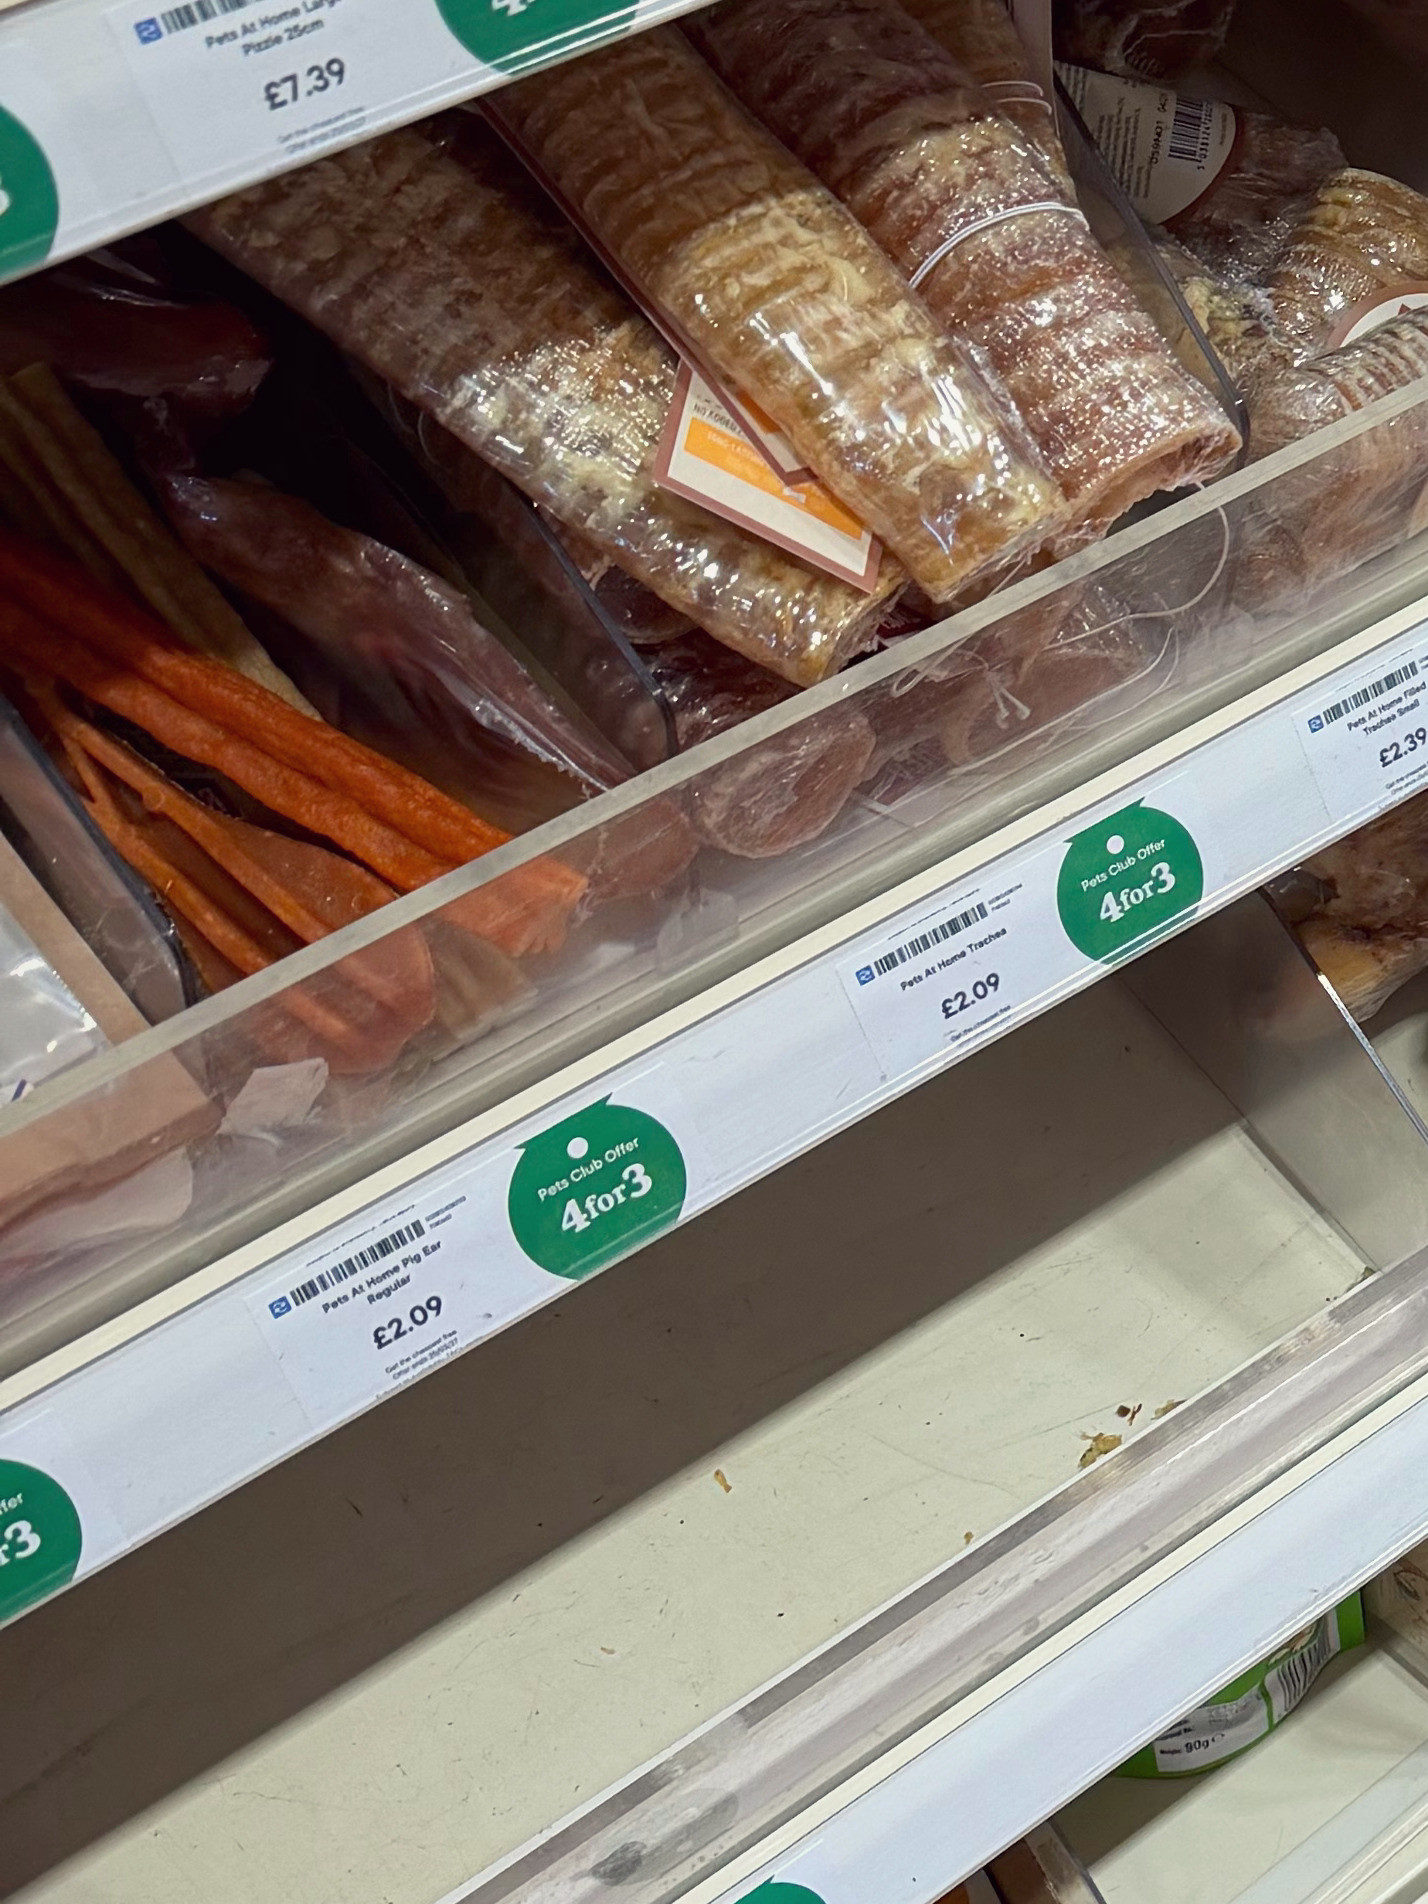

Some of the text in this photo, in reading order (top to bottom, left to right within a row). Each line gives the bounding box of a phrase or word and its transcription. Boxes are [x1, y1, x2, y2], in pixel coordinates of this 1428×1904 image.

[206, 28, 238, 49] Pets
[242, 20, 257, 36] At
[259, 7, 301, 31] Home
[286, 18, 324, 42] 25cm
[264, 58, 346, 110] £7.39
[1379, 727, 1428, 768] £2.39
[1099, 861, 1176, 924] 4for3
[900, 927, 1007, 992] Pets At Home Trachea
[941, 972, 1001, 1020] £2.09
[537, 1137, 640, 1202] Pets Club Offer
[561, 1162, 653, 1234] 4for3
[322, 1240, 442, 1314] Pets At Home Pig Ear
[367, 1274, 411, 1306] Regular
[373, 1295, 443, 1350] £2.09
